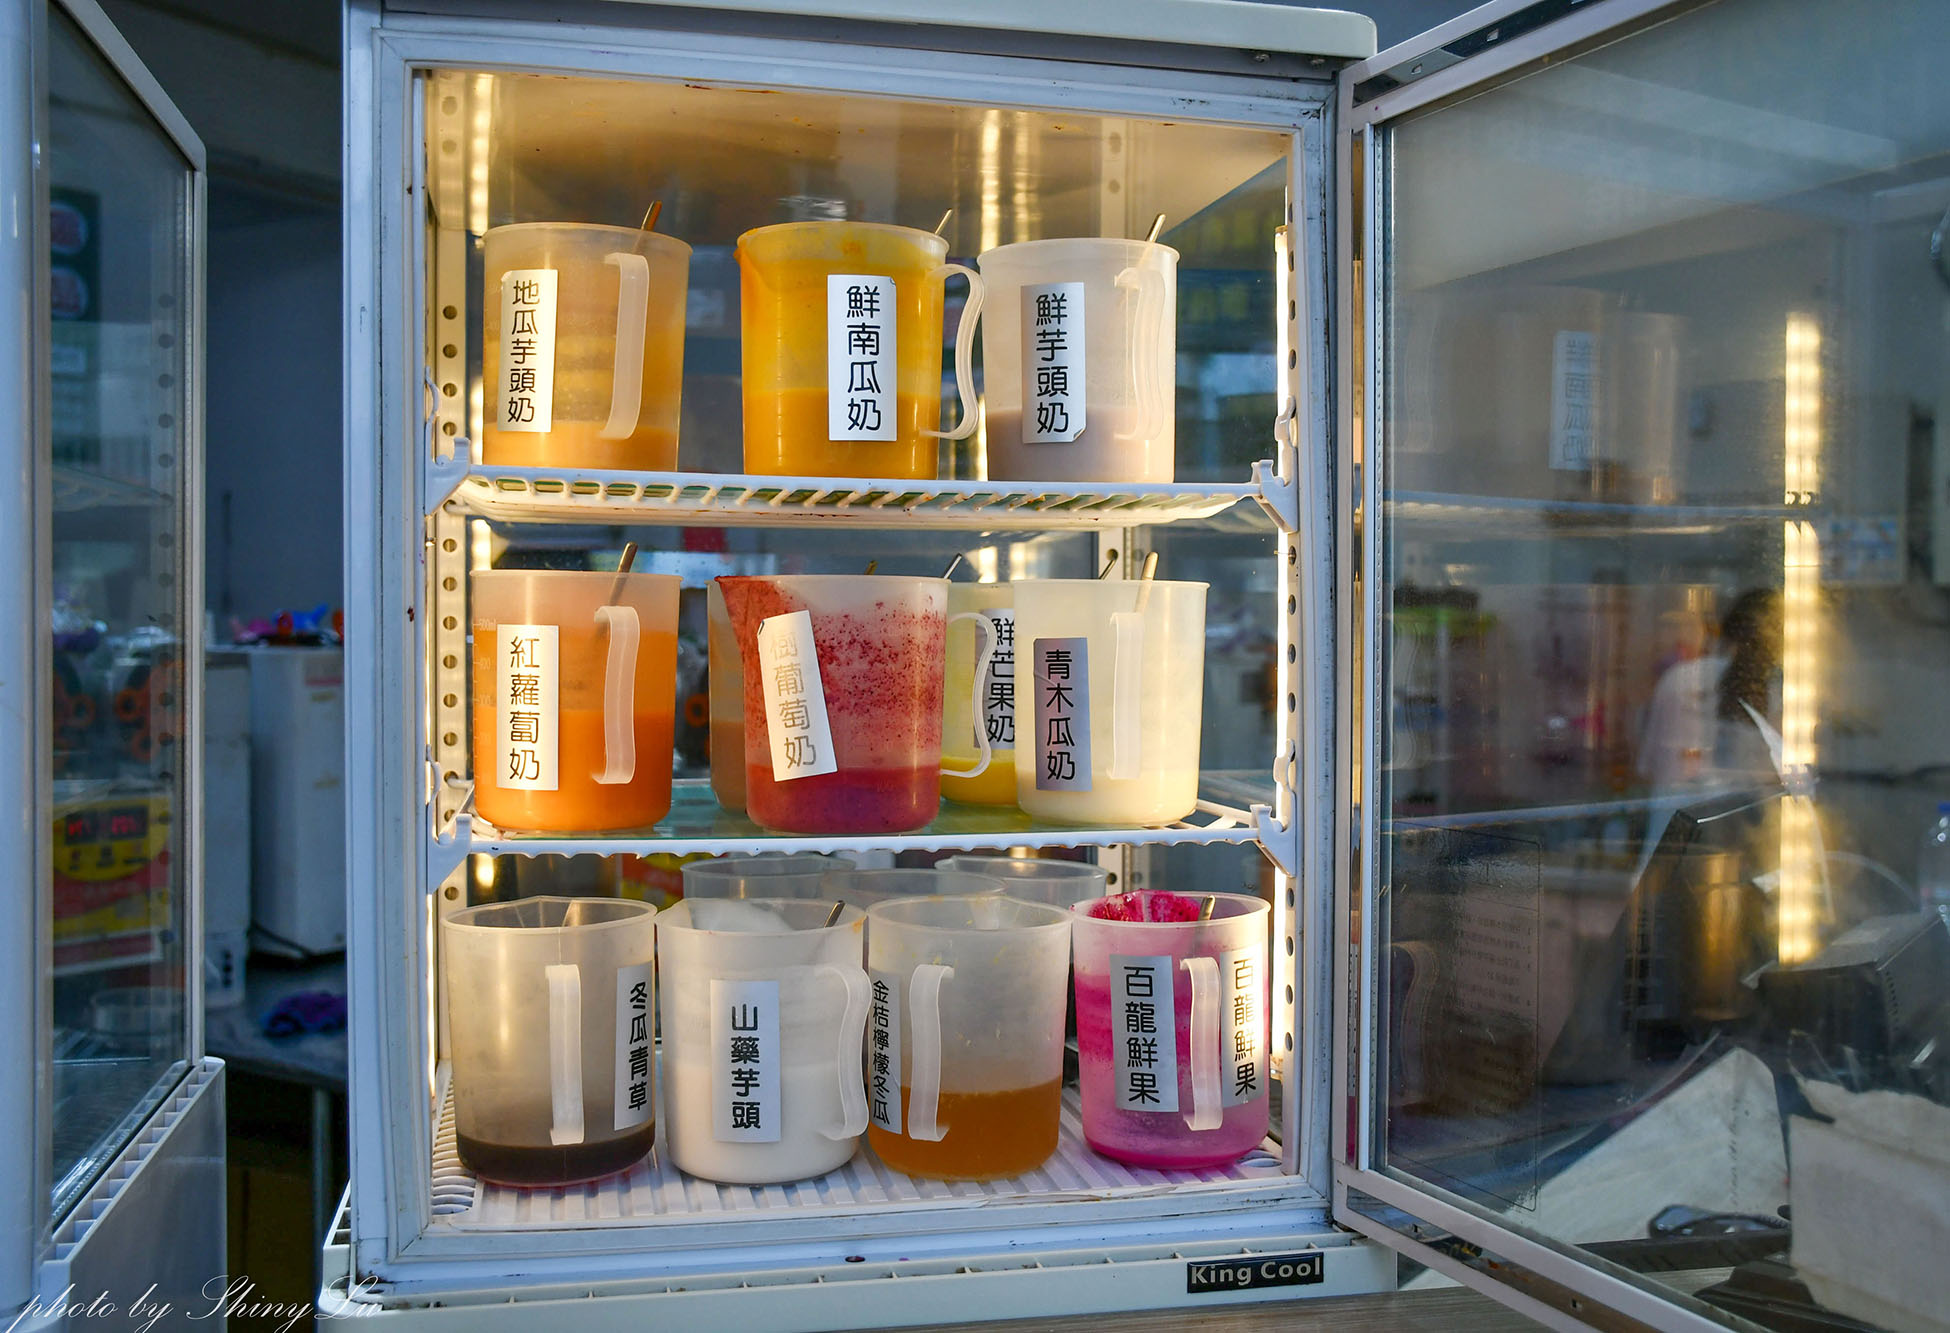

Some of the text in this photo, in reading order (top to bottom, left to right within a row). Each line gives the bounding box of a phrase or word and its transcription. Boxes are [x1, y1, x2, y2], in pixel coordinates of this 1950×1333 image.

[507, 279, 540, 423] 地瓜芋頭奶
[846, 285, 882, 431] 鮮南瓜奶
[1035, 292, 1069, 434] 鮮芋頭奶
[509, 635, 541, 781] 紅蘿蔔奶
[1045, 649, 1076, 781] 青木瓜奶
[628, 981, 648, 1111] 冬瓜青草
[731, 1003, 761, 1129] 山藥芋頭
[873, 980, 890, 1125] 金桔檸檬冬瓜
[1123, 966, 1161, 1105] 百龍鮮果
[1233, 958, 1257, 1097] 百龍鮮果
[1191, 1257, 1321, 1286] King Cool
